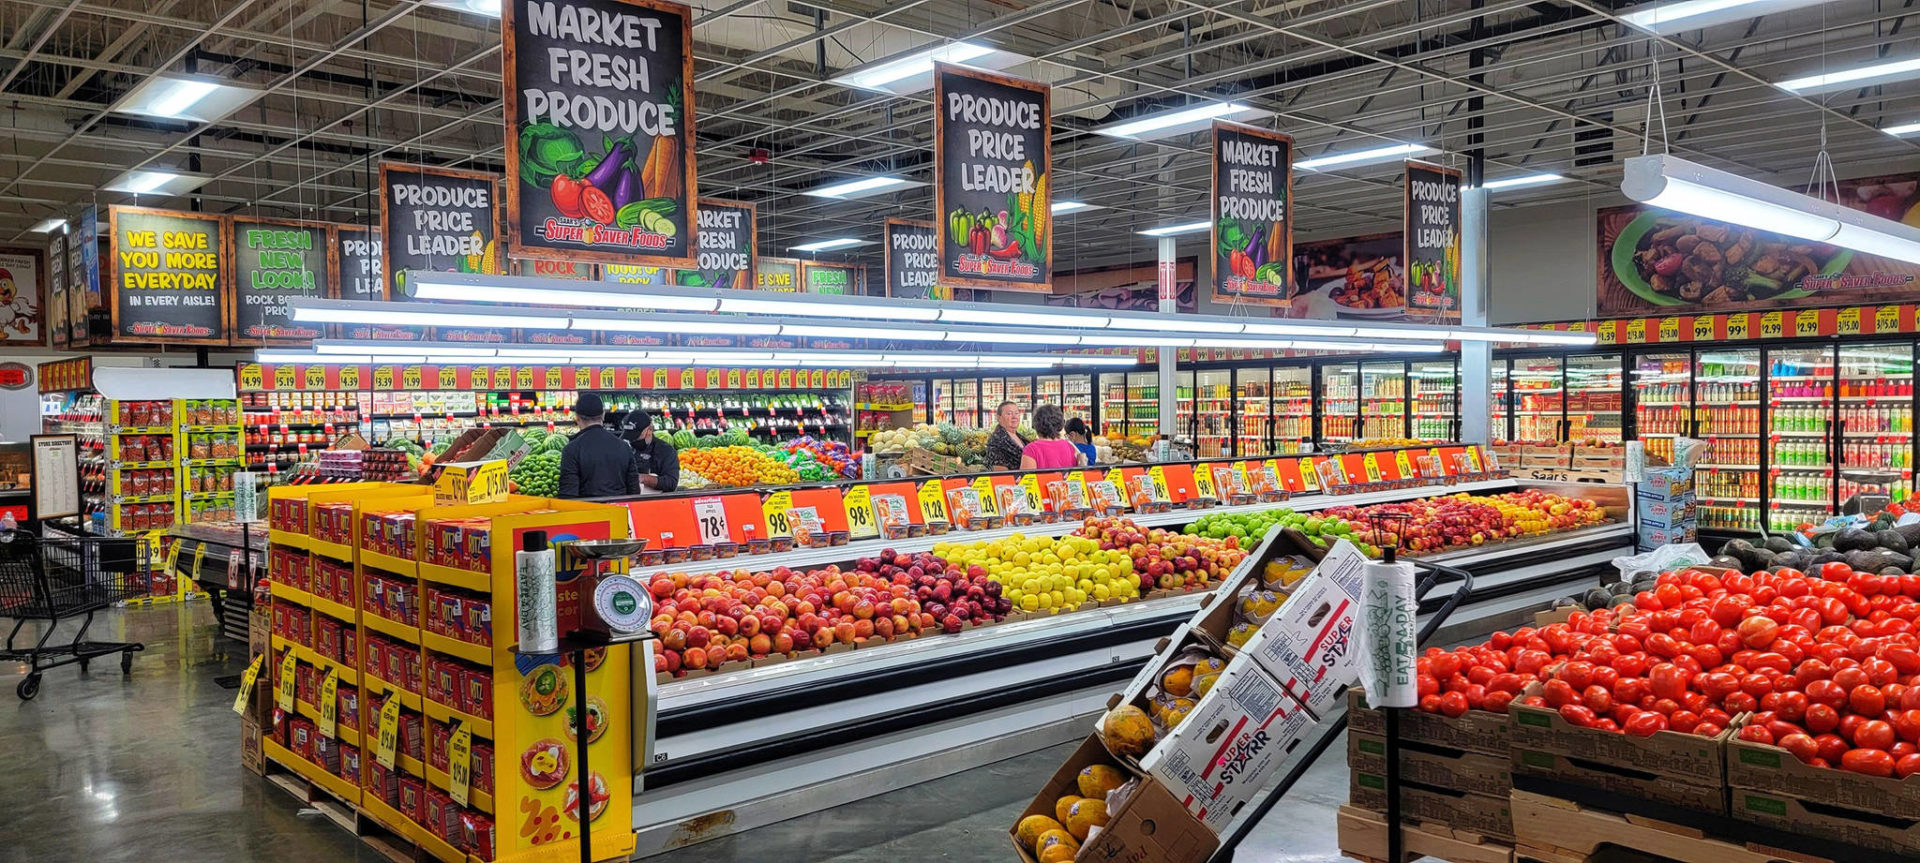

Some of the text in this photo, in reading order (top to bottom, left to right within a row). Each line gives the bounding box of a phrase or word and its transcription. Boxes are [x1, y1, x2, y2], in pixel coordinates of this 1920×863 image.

[528, 1, 662, 52] MARKET
[547, 48, 651, 93] FRESH
[523, 88, 676, 136] PRODUCE
[948, 92, 1041, 130] PRODUCE
[968, 129, 1026, 161] PRICE
[1222, 140, 1279, 168] MARKET
[961, 163, 1035, 194] LEADER
[1230, 169, 1273, 195] FRESH
[391, 183, 489, 208] PRODUCE
[1411, 181, 1456, 203] PRODUCE
[1220, 196, 1284, 222] PRODUCE
[1421, 204, 1450, 225] PRICE
[413, 210, 473, 232] PRICE
[696, 210, 742, 229] ARKET
[126, 231, 208, 249] WE SAVE
[247, 229, 312, 250] FRESH
[545, 219, 667, 248] SUPER SAVER FOODS
[698, 231, 735, 250] RESH
[892, 233, 937, 251] PRODUC
[1418, 228, 1454, 248] LEADER
[407, 235, 484, 256] LEADER
[120, 251, 218, 270] YOU MORE
[259, 250, 304, 270] NEW
[534, 260, 576, 275] ROCK
[698, 253, 748, 271] ODUCE
[959, 255, 1033, 275] SUPER SAVER FOODS
[123, 271, 218, 290] EVERYDAY
[251, 270, 316, 290] LOOK!
[355, 278, 383, 294] LEA
[768, 272, 791, 286] SAVE
[813, 271, 847, 285] FRESH
[901, 271, 937, 287] LEADE
[1802, 271, 1907, 291] SUPER SAVER FOODS
[129, 295, 216, 307] IN EVERY AISLE!
[246, 295, 274, 305] ROCK
[264, 304, 287, 316] PRIC
[1694, 327, 1712, 337] 99¢
[1728, 325, 1746, 335] 99¢
[1761, 324, 1781, 334] $2.99
[1796, 323, 1817, 332] $2.99
[242, 377, 261, 387] $4.99
[276, 377, 294, 387] $5.19
[306, 376, 325, 386] $6.99
[340, 377, 358, 386] $4.39
[404, 377, 420, 386] $1.99
[507, 449, 524, 467] Fresh
[1530, 470, 1568, 481] Saar's
[1197, 480, 1211, 496] 98¢
[922, 500, 944, 519] $1.28
[1028, 492, 1039, 509] 8¢
[849, 506, 870, 527] 98¢
[700, 516, 725, 539] 78¢
[442, 530, 456, 552] RITZ
[468, 534, 483, 556] RITZ
[547, 540, 589, 572] ITZ
[558, 590, 579, 602] ste
[442, 603, 456, 623] RITZ
[468, 608, 483, 629] RITZ
[557, 605, 578, 616] cor
[1395, 594, 1409, 624] DAY
[1320, 616, 1353, 651] SUPER
[1396, 657, 1409, 686] EAT
[470, 679, 484, 701] RITZ
[1220, 732, 1252, 768] SUPER
